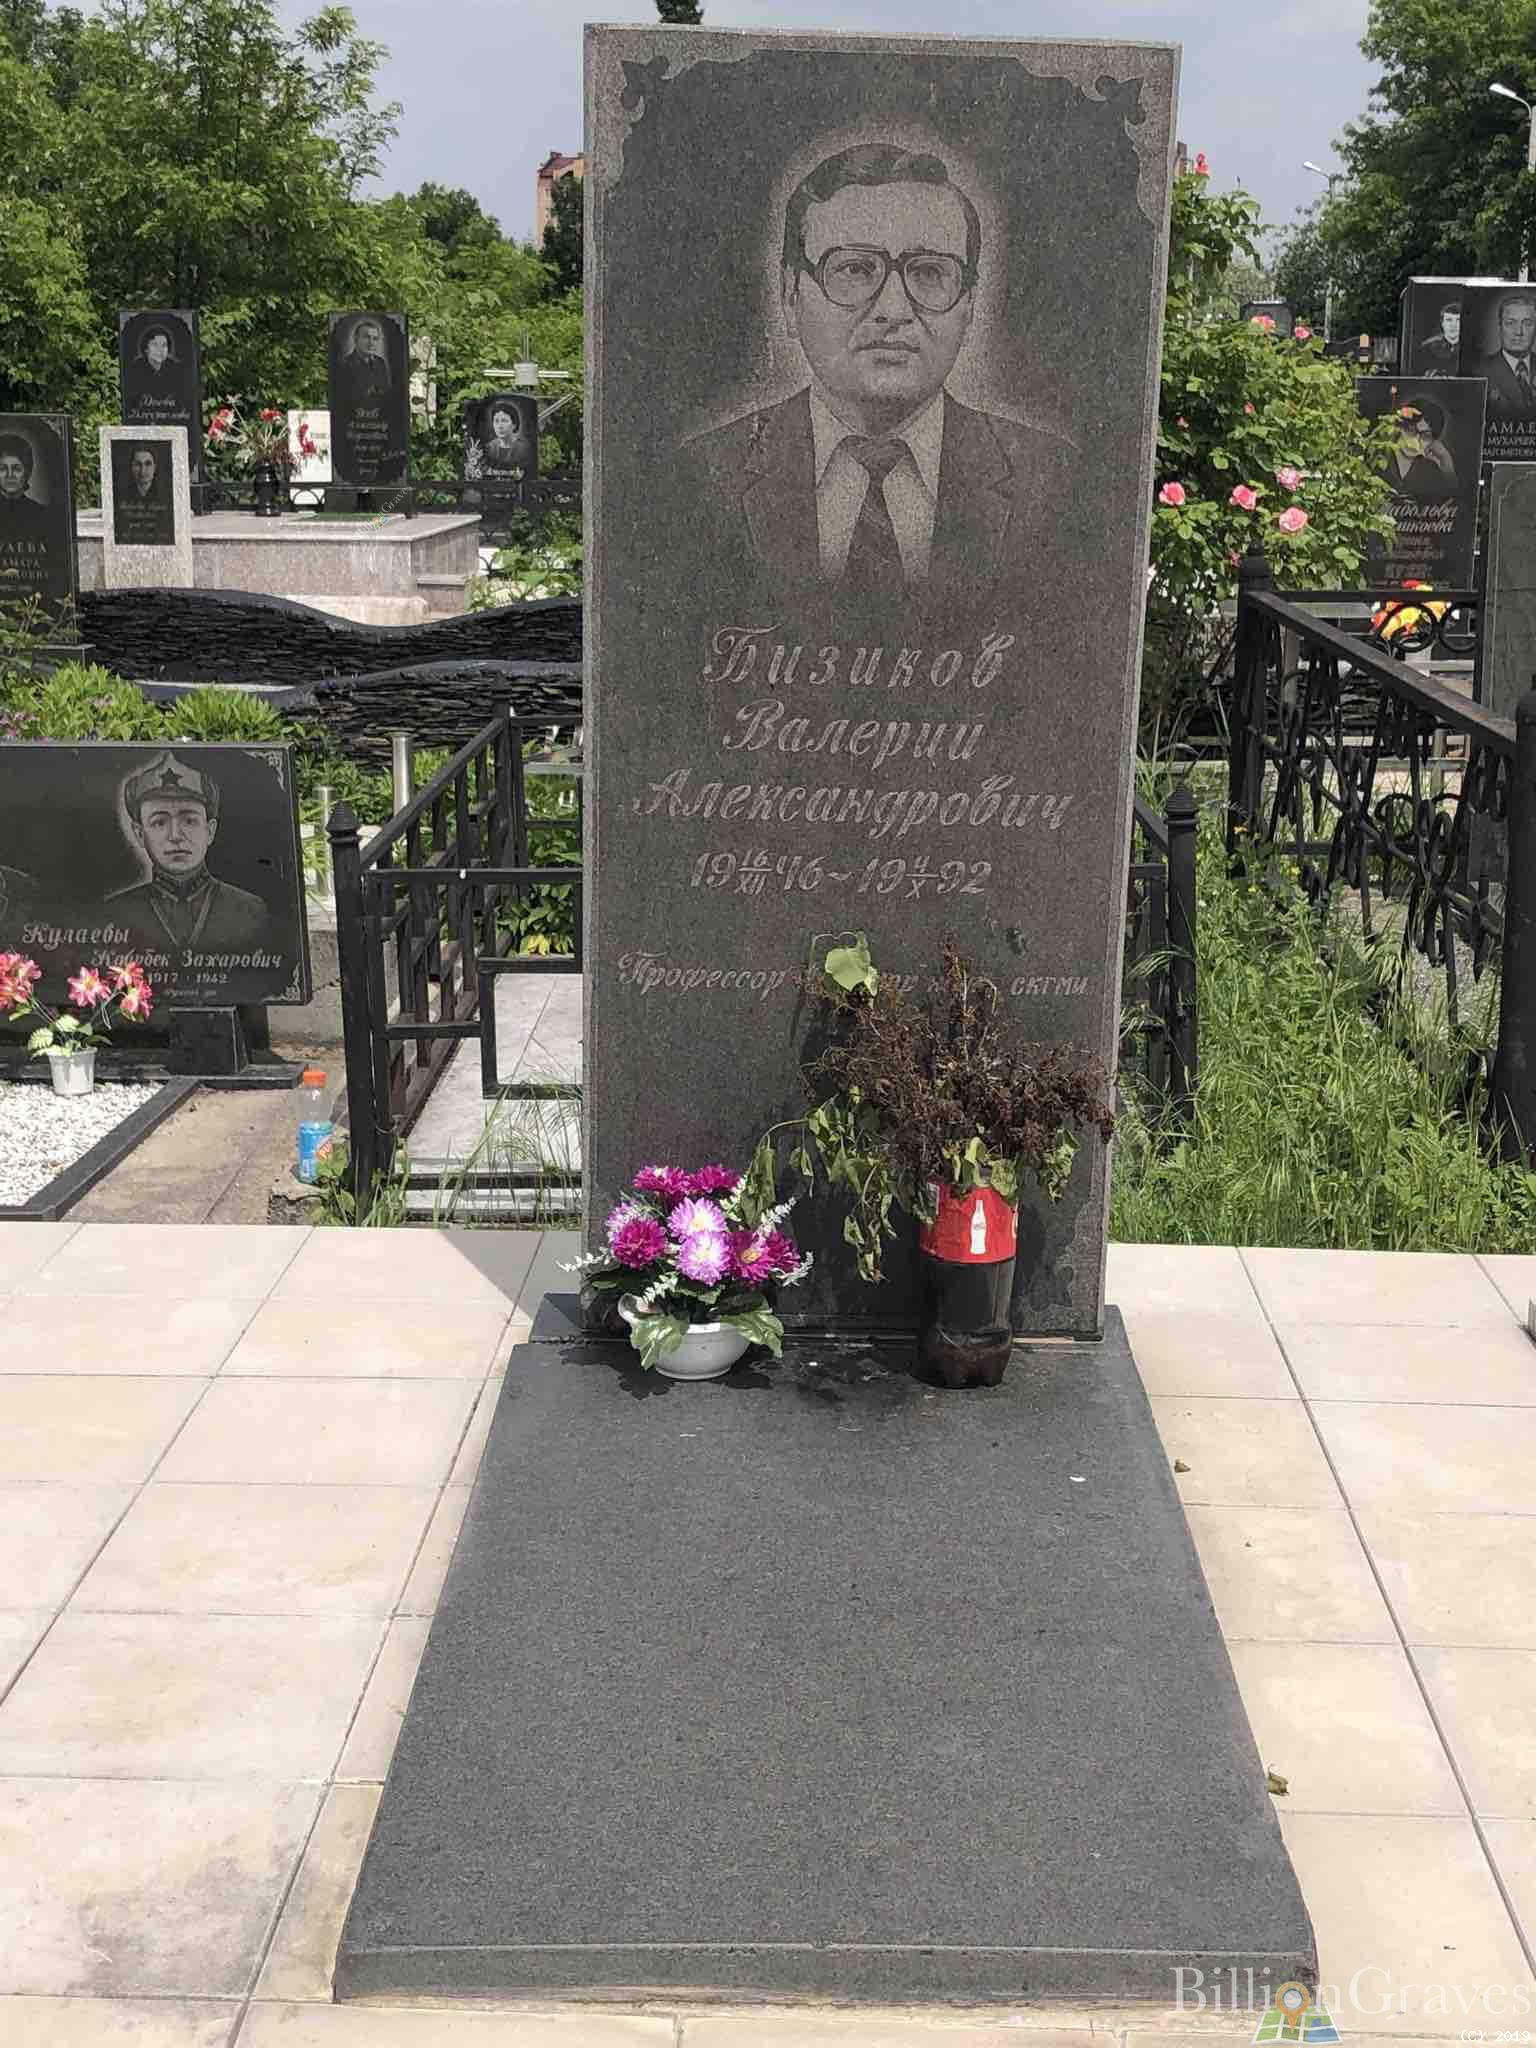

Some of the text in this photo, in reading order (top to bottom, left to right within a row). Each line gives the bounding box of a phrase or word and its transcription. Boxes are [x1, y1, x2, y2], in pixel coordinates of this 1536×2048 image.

[702, 624, 1016, 688] Бизиков
[632, 768, 1073, 839] Александрович
[22, 922, 130, 951] Кулаевы
[617, 950, 788, 996] Профессор
